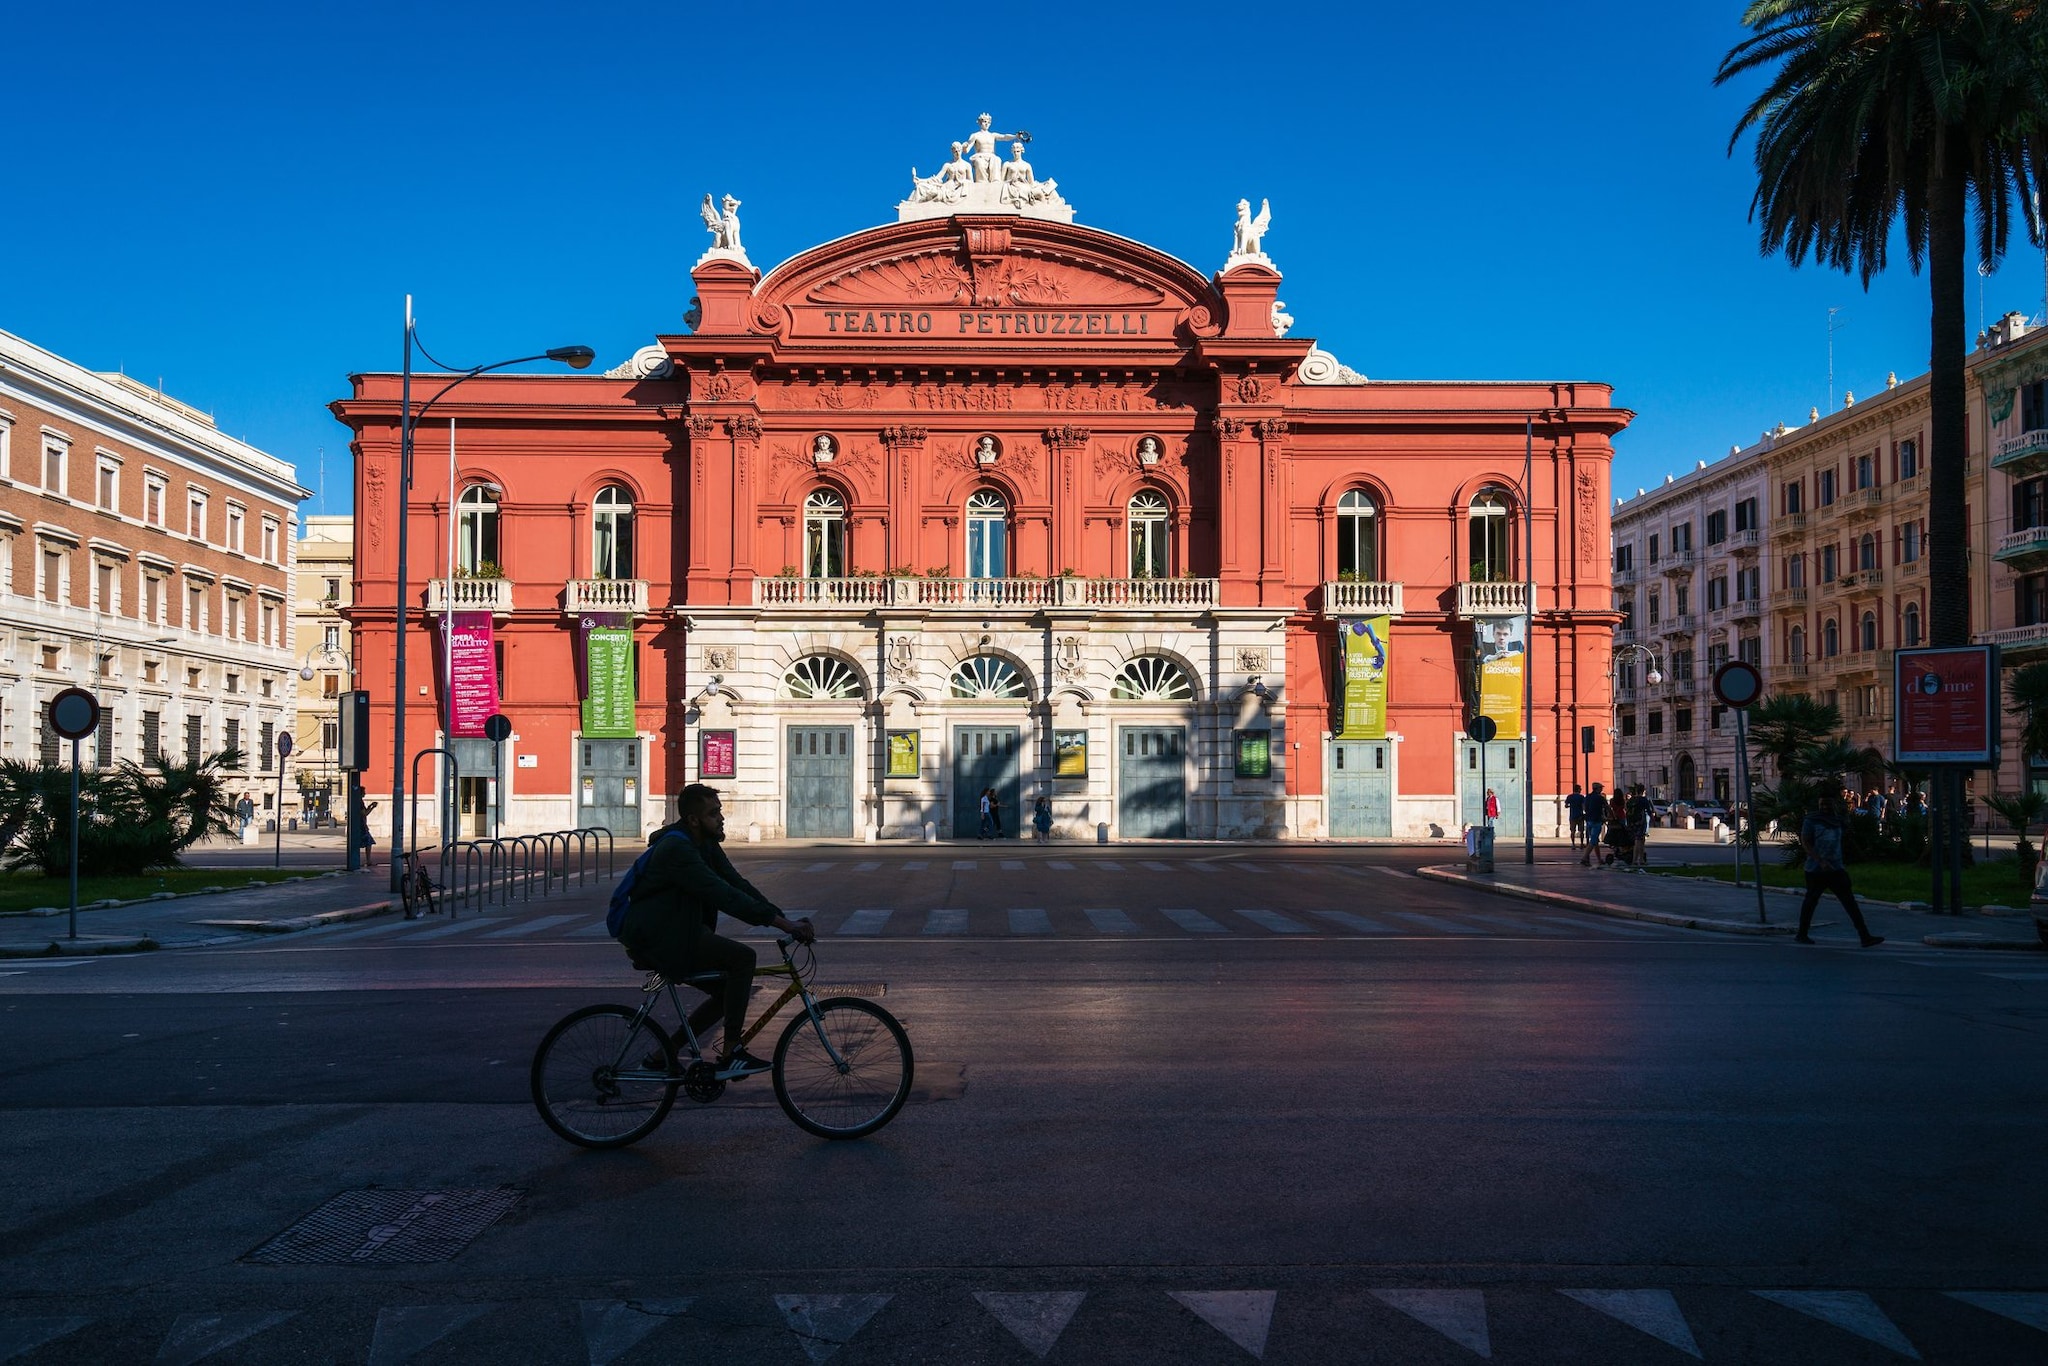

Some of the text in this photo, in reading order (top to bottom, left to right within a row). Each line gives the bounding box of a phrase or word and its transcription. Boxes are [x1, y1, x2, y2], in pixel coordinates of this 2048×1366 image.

[825, 311, 1148, 335] TEATRO PETRUZZELLI
[590, 633, 627, 641] CONCERTI
[452, 638, 489, 647] BALLETTO
